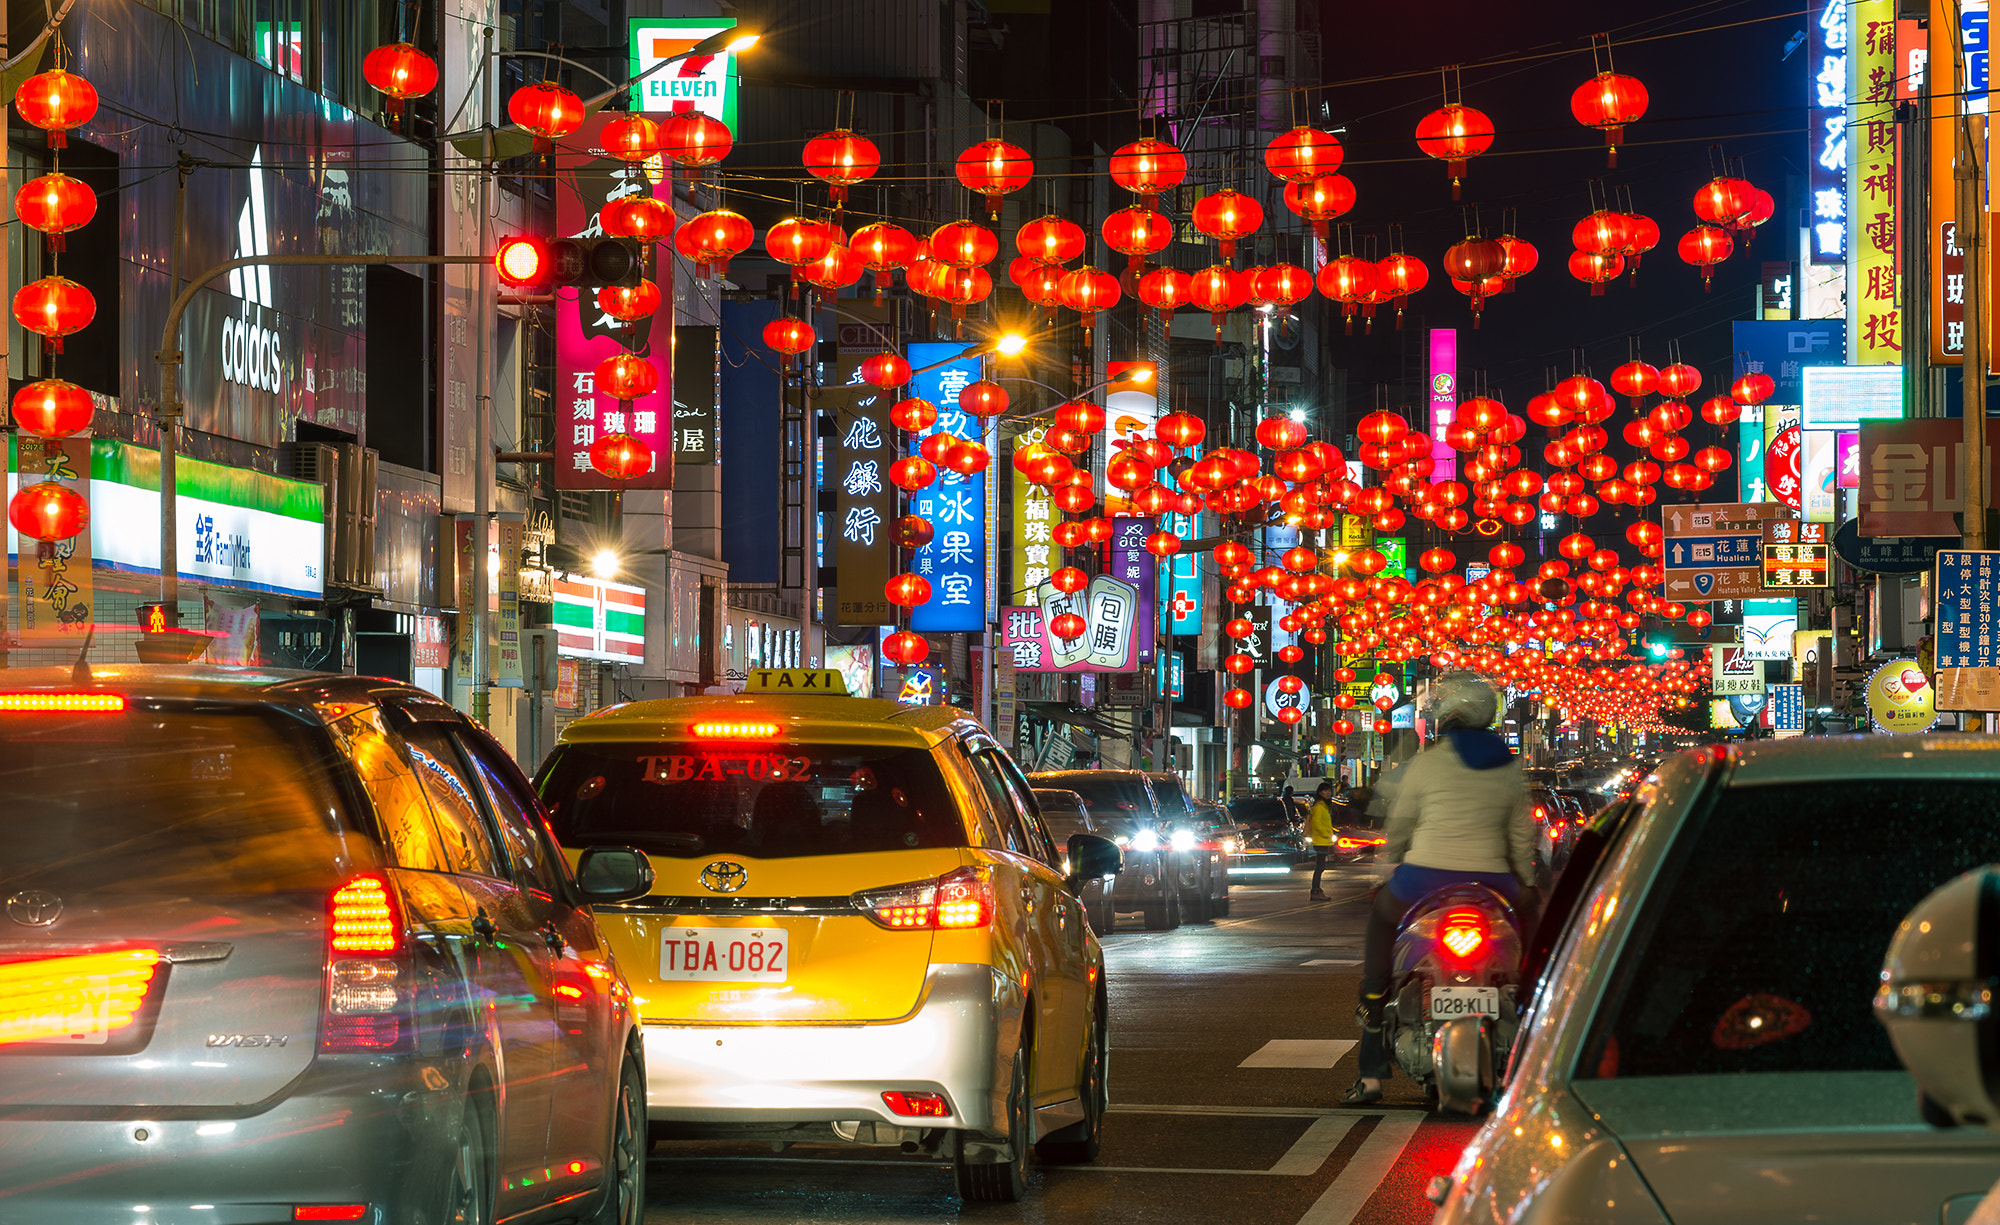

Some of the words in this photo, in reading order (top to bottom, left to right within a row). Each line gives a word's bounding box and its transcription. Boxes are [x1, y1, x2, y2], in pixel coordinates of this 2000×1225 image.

[1863, 20, 1902, 366] 彌勒財神電腦投
[221, 299, 281, 394] adidas
[573, 371, 595, 473] 石刻印章
[195, 513, 214, 564] 全家
[920, 500, 933, 575] 四水果
[1699, 577, 1709, 586] 9
[1094, 597, 1121, 651] 包膜
[1941, 554, 1955, 667] 及小型車
[1008, 611, 1042, 668] 批發
[757, 672, 831, 688] TAXI
[636, 755, 811, 782] TBA-082
[206, 1033, 289, 1048] WISH
